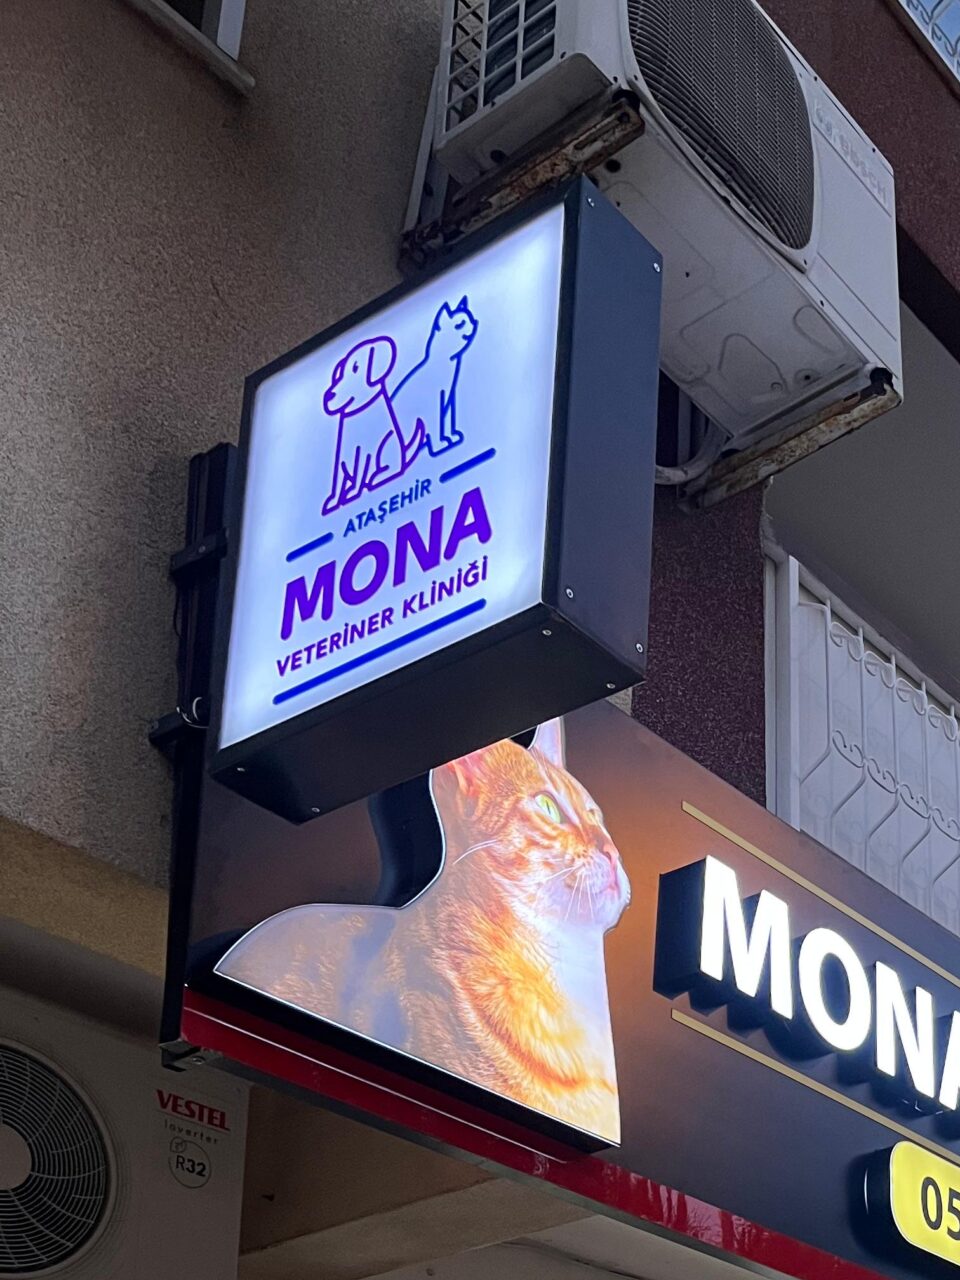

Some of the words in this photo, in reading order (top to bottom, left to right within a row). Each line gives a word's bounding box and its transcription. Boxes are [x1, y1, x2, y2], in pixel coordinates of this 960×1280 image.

[342, 477, 433, 538] ATAŞEHİR
[279, 486, 493, 641] MONA
[276, 606, 395, 678] VETERİNER
[402, 555, 489, 619] KLİNİĞİ
[156, 1088, 231, 1132] VESTEL
[175, 1154, 207, 1178] R32
